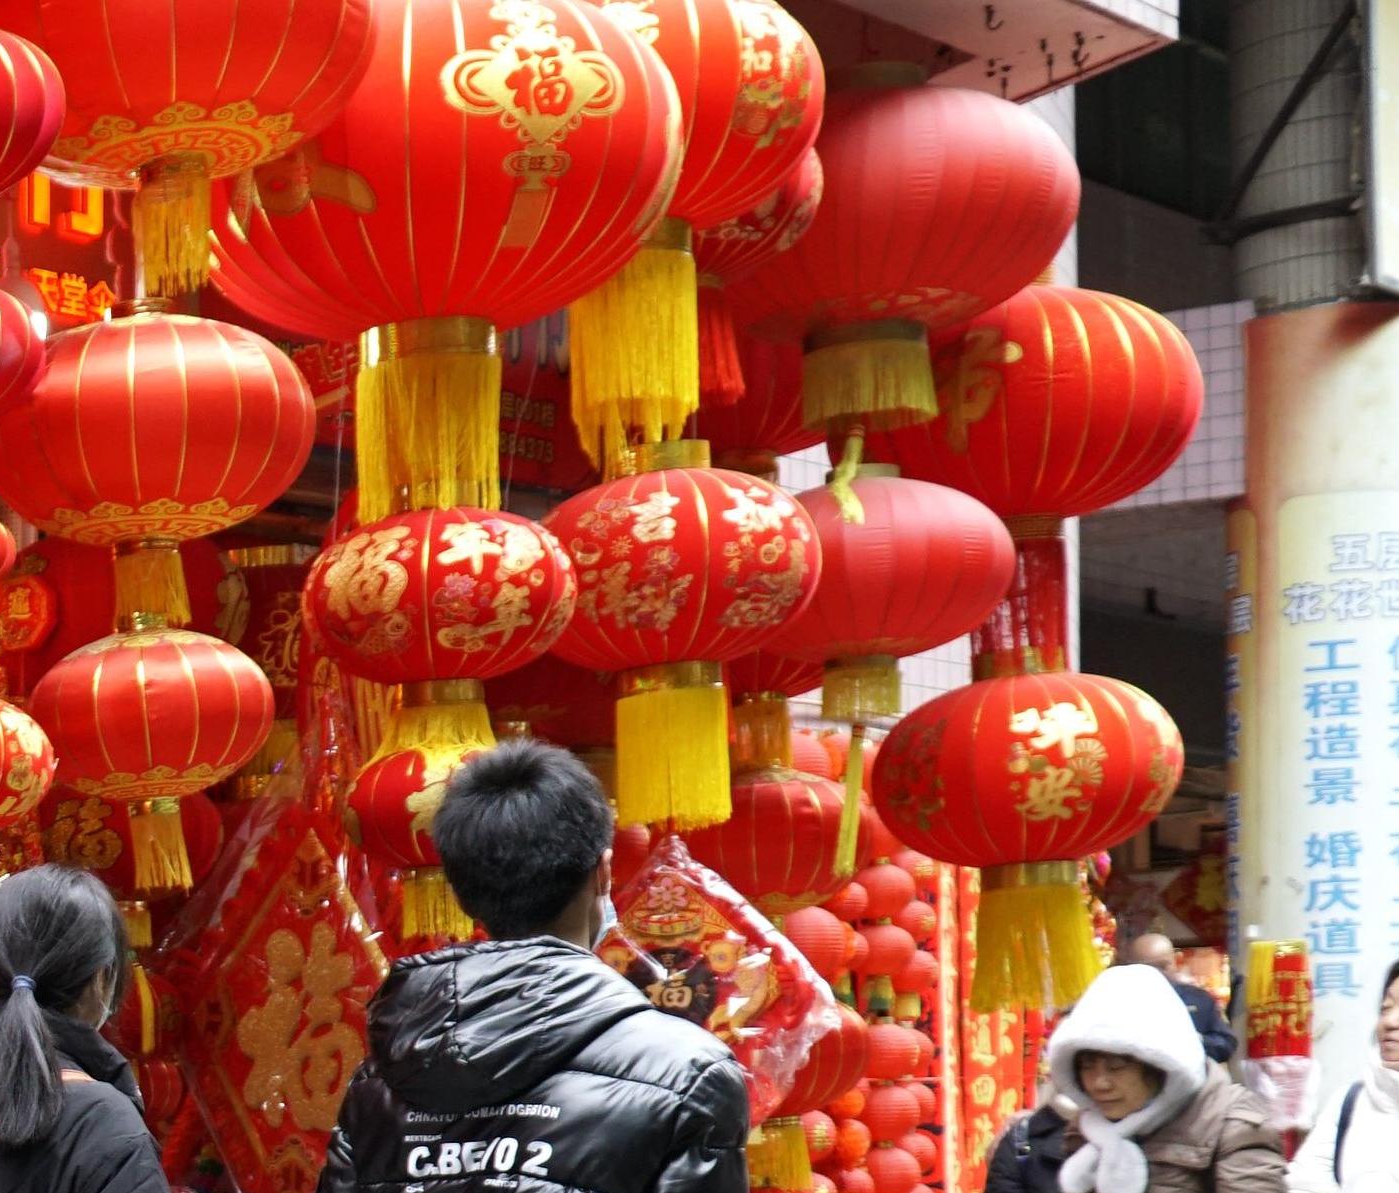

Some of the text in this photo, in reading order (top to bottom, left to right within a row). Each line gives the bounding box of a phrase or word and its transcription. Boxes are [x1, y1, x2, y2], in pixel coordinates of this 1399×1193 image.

[505, 47, 574, 118] 福
[324, 526, 410, 621] 福
[1304, 638, 1363, 998] 工程造景 婚庆道具
[237, 921, 369, 1131] 福
